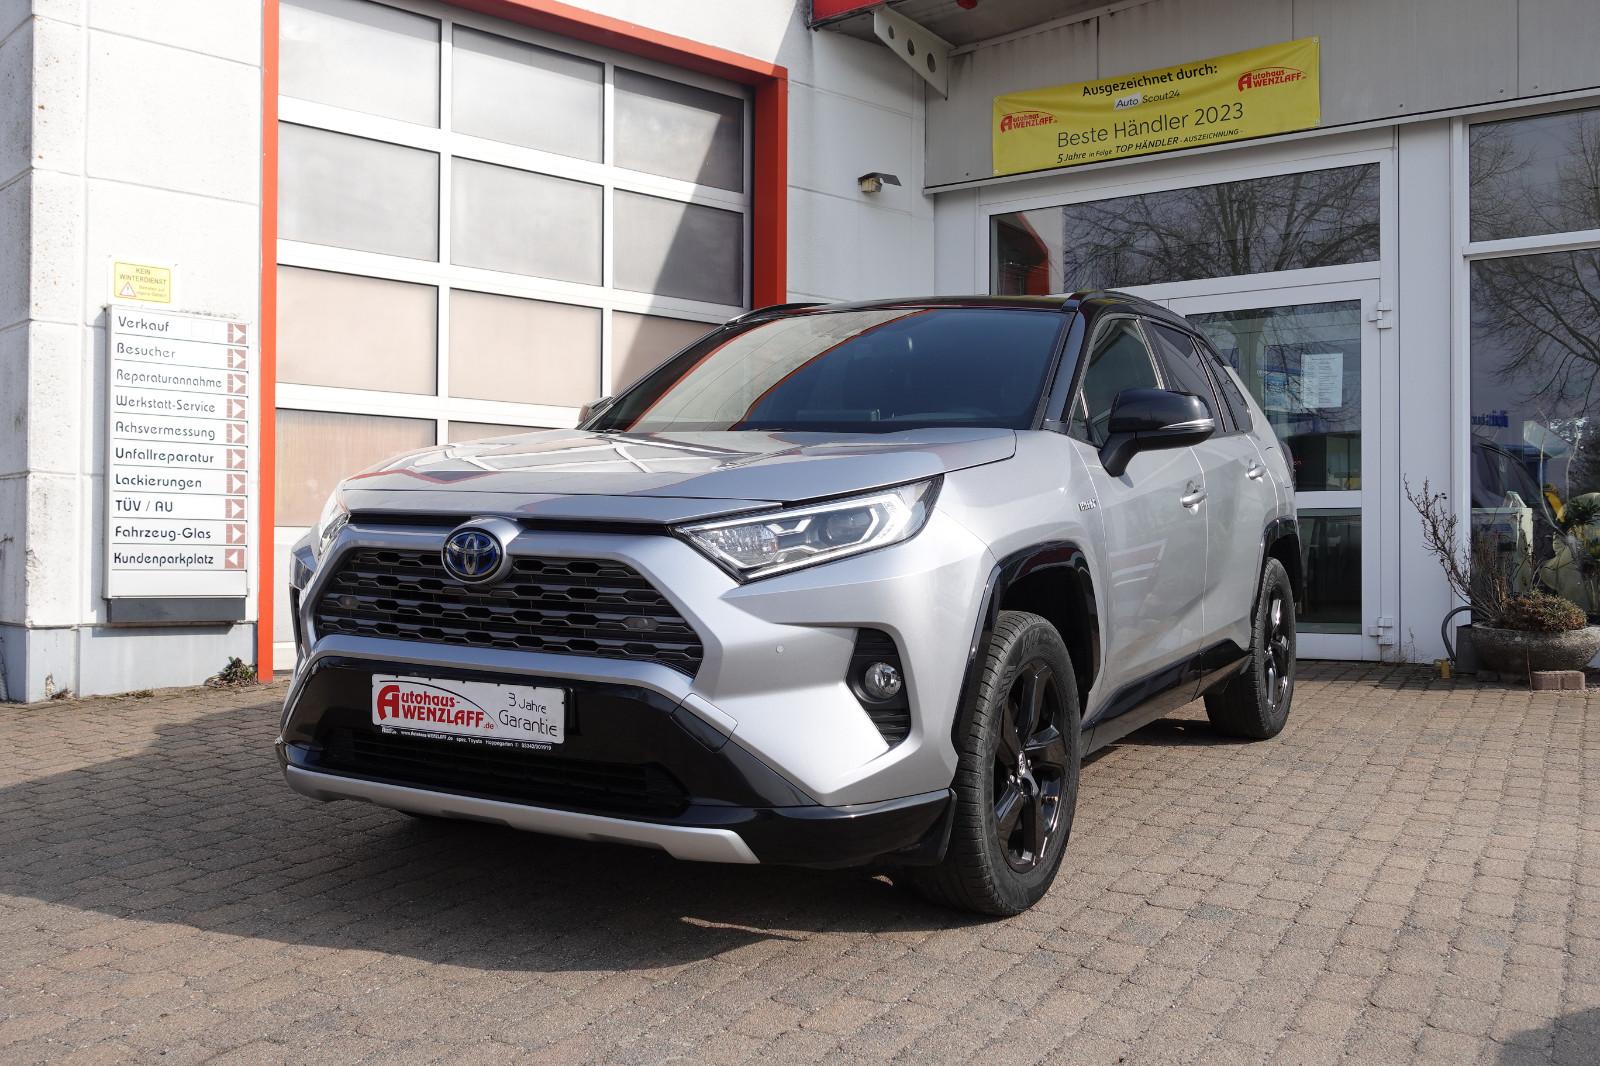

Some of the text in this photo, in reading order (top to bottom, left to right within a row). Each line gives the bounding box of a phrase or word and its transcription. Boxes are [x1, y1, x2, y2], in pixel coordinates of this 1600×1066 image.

[1082, 64, 1218, 97] Ausgezeichnet durch:
[1237, 69, 1285, 92] Autohaus
[1115, 89, 1180, 108] Auto Scout24
[1000, 113, 1040, 133] Autohaus
[1057, 102, 1243, 148] Beste Händler 2023
[1057, 154, 1063, 164] 5
[1063, 152, 1087, 162] Jahre
[1095, 149, 1113, 158] Folge
[1115, 144, 1133, 153] TOP
[1135, 136, 1179, 150] HÄNDLER
[120, 273, 166, 285] WINTERDIENST
[136, 267, 151, 275] KEIN
[118, 316, 170, 332] Verkauf
[116, 342, 176, 358] Besucher
[116, 368, 222, 388] Reparaturannahme
[116, 395, 216, 413] Werkstatt-Service
[115, 421, 215, 440] Achsvermessung
[115, 447, 214, 464] Unfallreparatur
[115, 473, 202, 490] Lackierungen
[115, 497, 141, 511] TÜV
[155, 501, 173, 512] AU
[115, 526, 211, 541] Fahrzeug-Glas
[114, 552, 214, 567] Kundenparkplatz
[508, 692, 547, 715] 3 Jahre
[499, 710, 558, 737] Garantie
